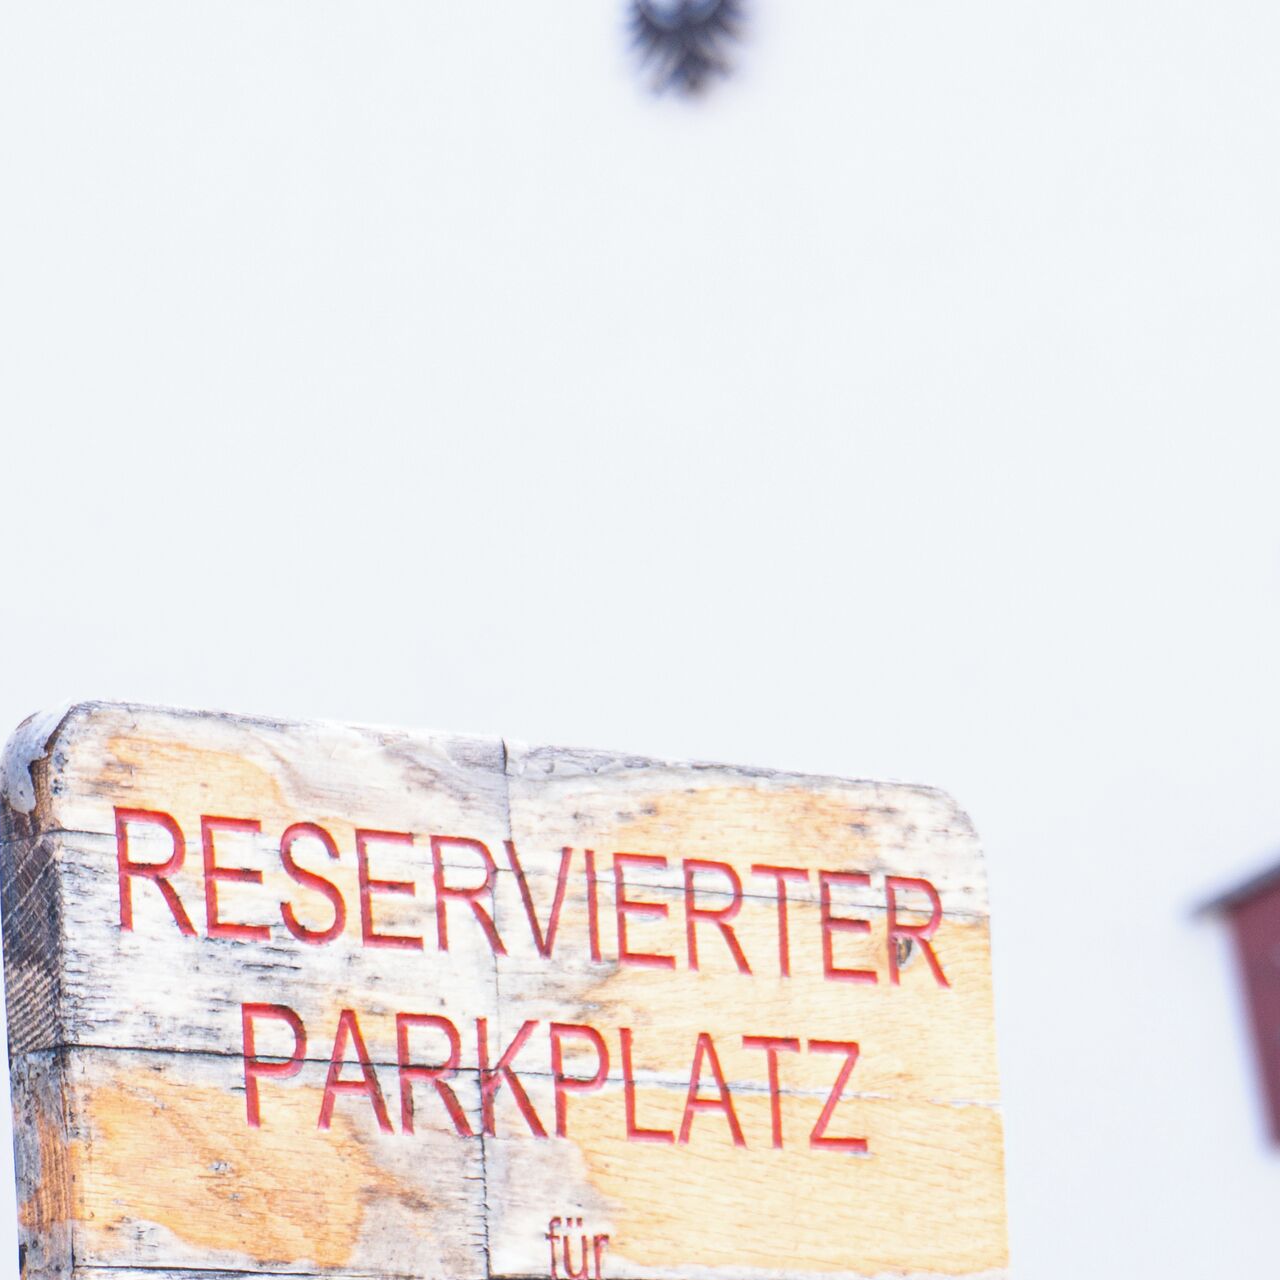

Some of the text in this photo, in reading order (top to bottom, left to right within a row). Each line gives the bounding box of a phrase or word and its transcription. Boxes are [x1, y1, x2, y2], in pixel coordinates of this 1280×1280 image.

[113, 806, 951, 989] RESERVIERTER
[240, 1002, 869, 1153] PARKPLATZ
[545, 1216, 610, 1280] für
